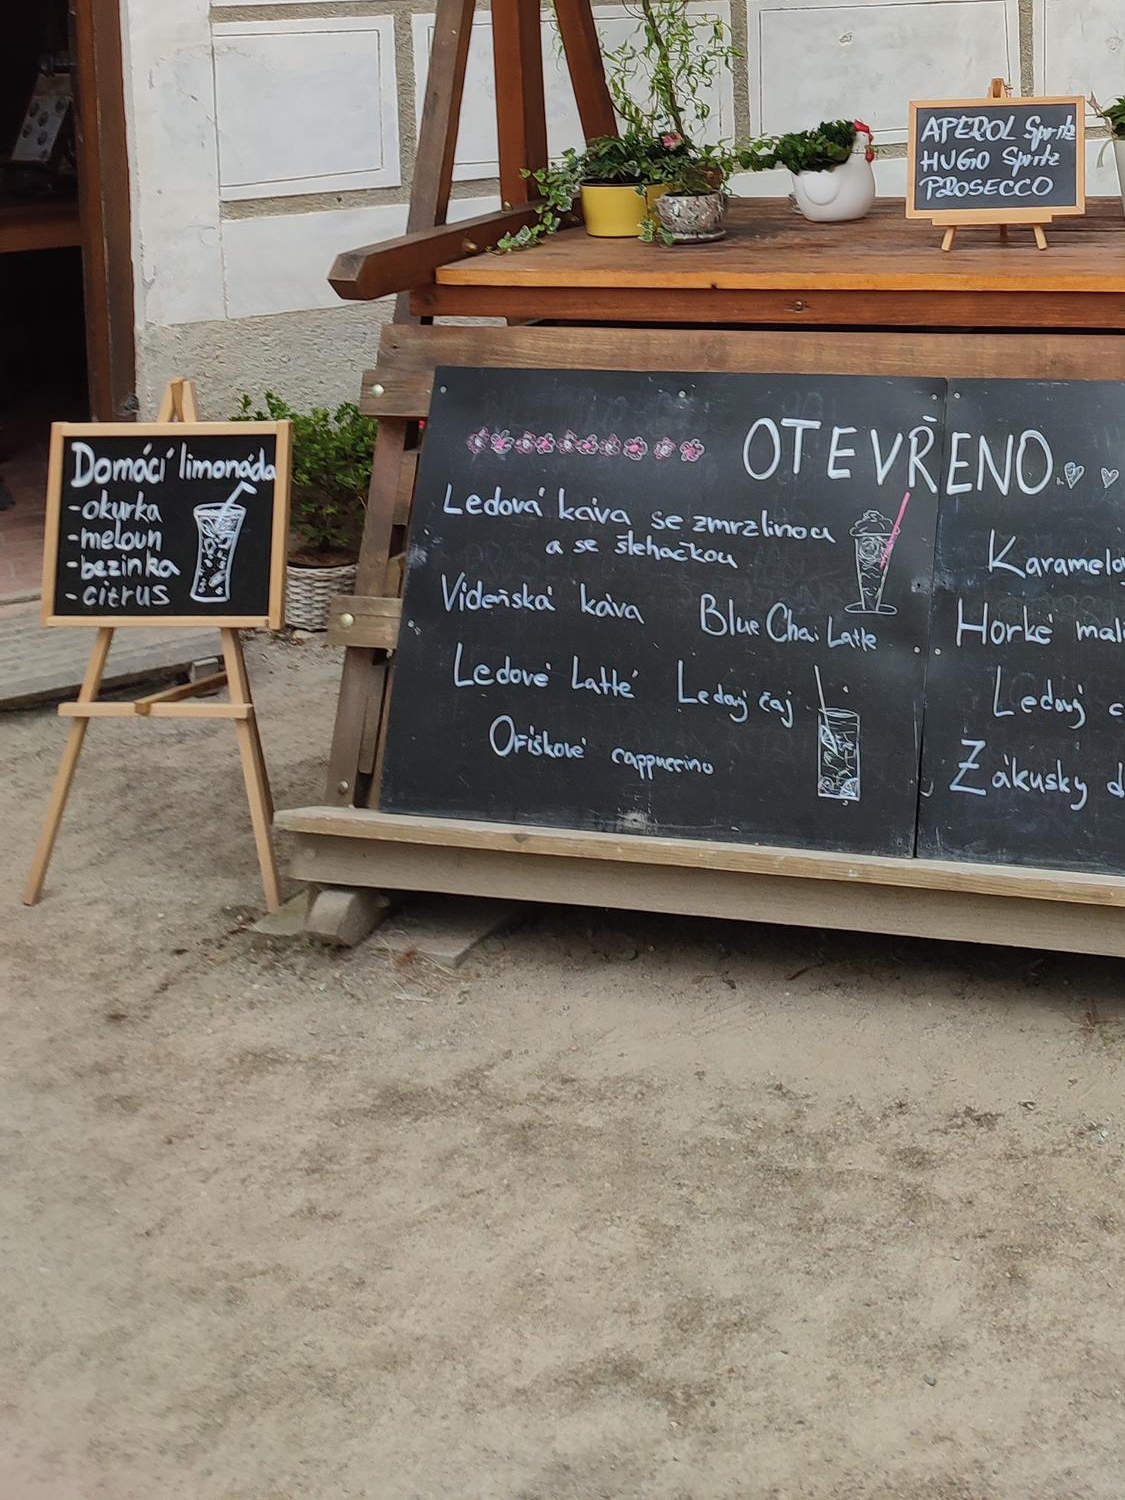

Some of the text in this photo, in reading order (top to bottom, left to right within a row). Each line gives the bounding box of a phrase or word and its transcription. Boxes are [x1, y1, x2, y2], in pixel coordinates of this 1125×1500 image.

[920, 115, 1017, 144] APEROL
[920, 144, 1061, 178] HUGO Spritz
[919, 176, 1053, 201] PROSECCO
[71, 441, 277, 488] Domácí limonáda
[742, 414, 1054, 496] OTEVŘENO
[442, 484, 836, 543] Ledová káva se zmrzlinou
[545, 540, 563, 555] a
[573, 537, 600, 554] se
[580, 584, 644, 624] káva
[700, 593, 878, 651] Blue Chai Latte
[955, 598, 1054, 648] Horké
[453, 642, 551, 688] Ledové
[758, 690, 794, 729] čaj
[949, 738, 1089, 811] Zákusky
